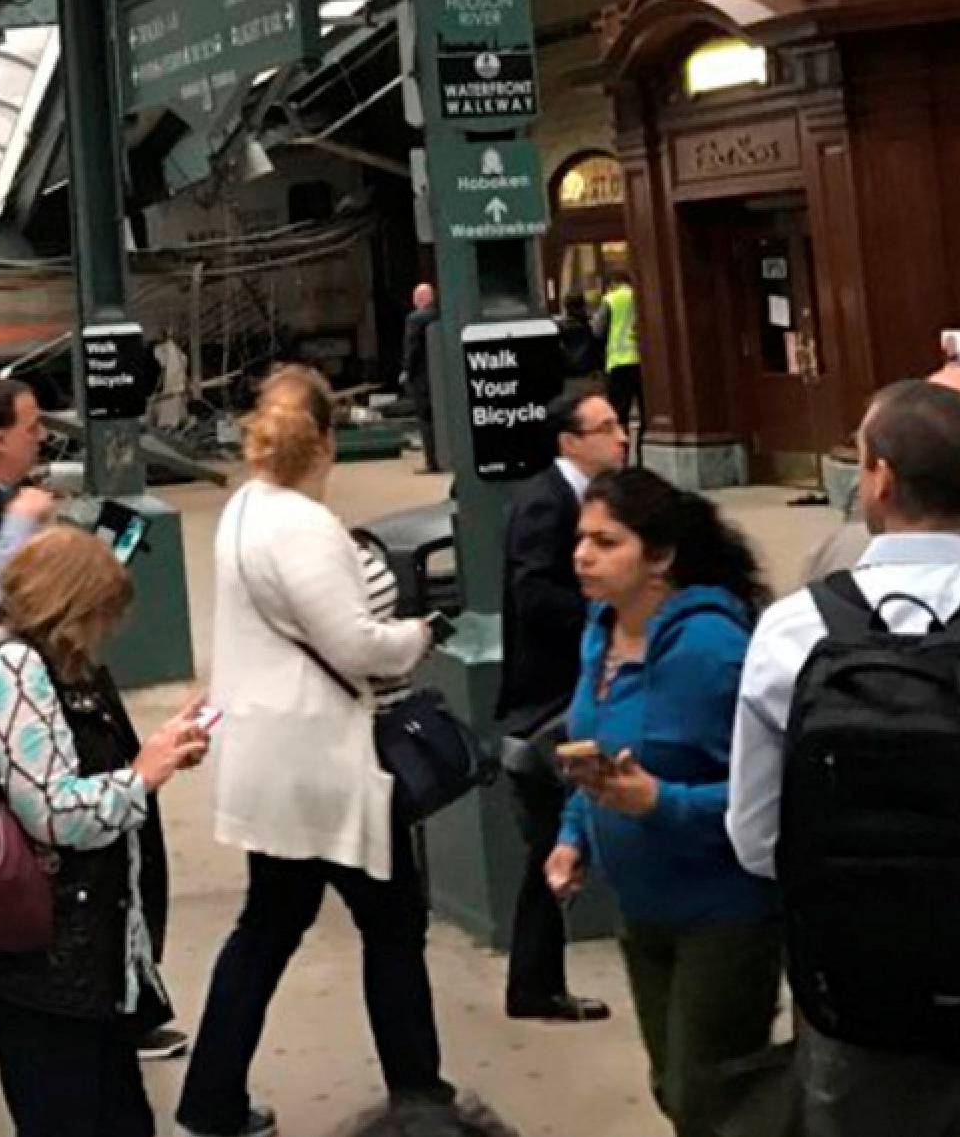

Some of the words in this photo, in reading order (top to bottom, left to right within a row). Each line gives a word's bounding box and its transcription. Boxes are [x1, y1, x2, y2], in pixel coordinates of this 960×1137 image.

[444, 82, 532, 97] WATERFRONT
[445, 97, 532, 114] WALKWAY
[457, 175, 528, 191] Hoboken
[85, 341, 117, 354] Walk
[467, 349, 518, 370] Walk
[471, 378, 519, 398] Your
[472, 402, 546, 428] Bicycle
